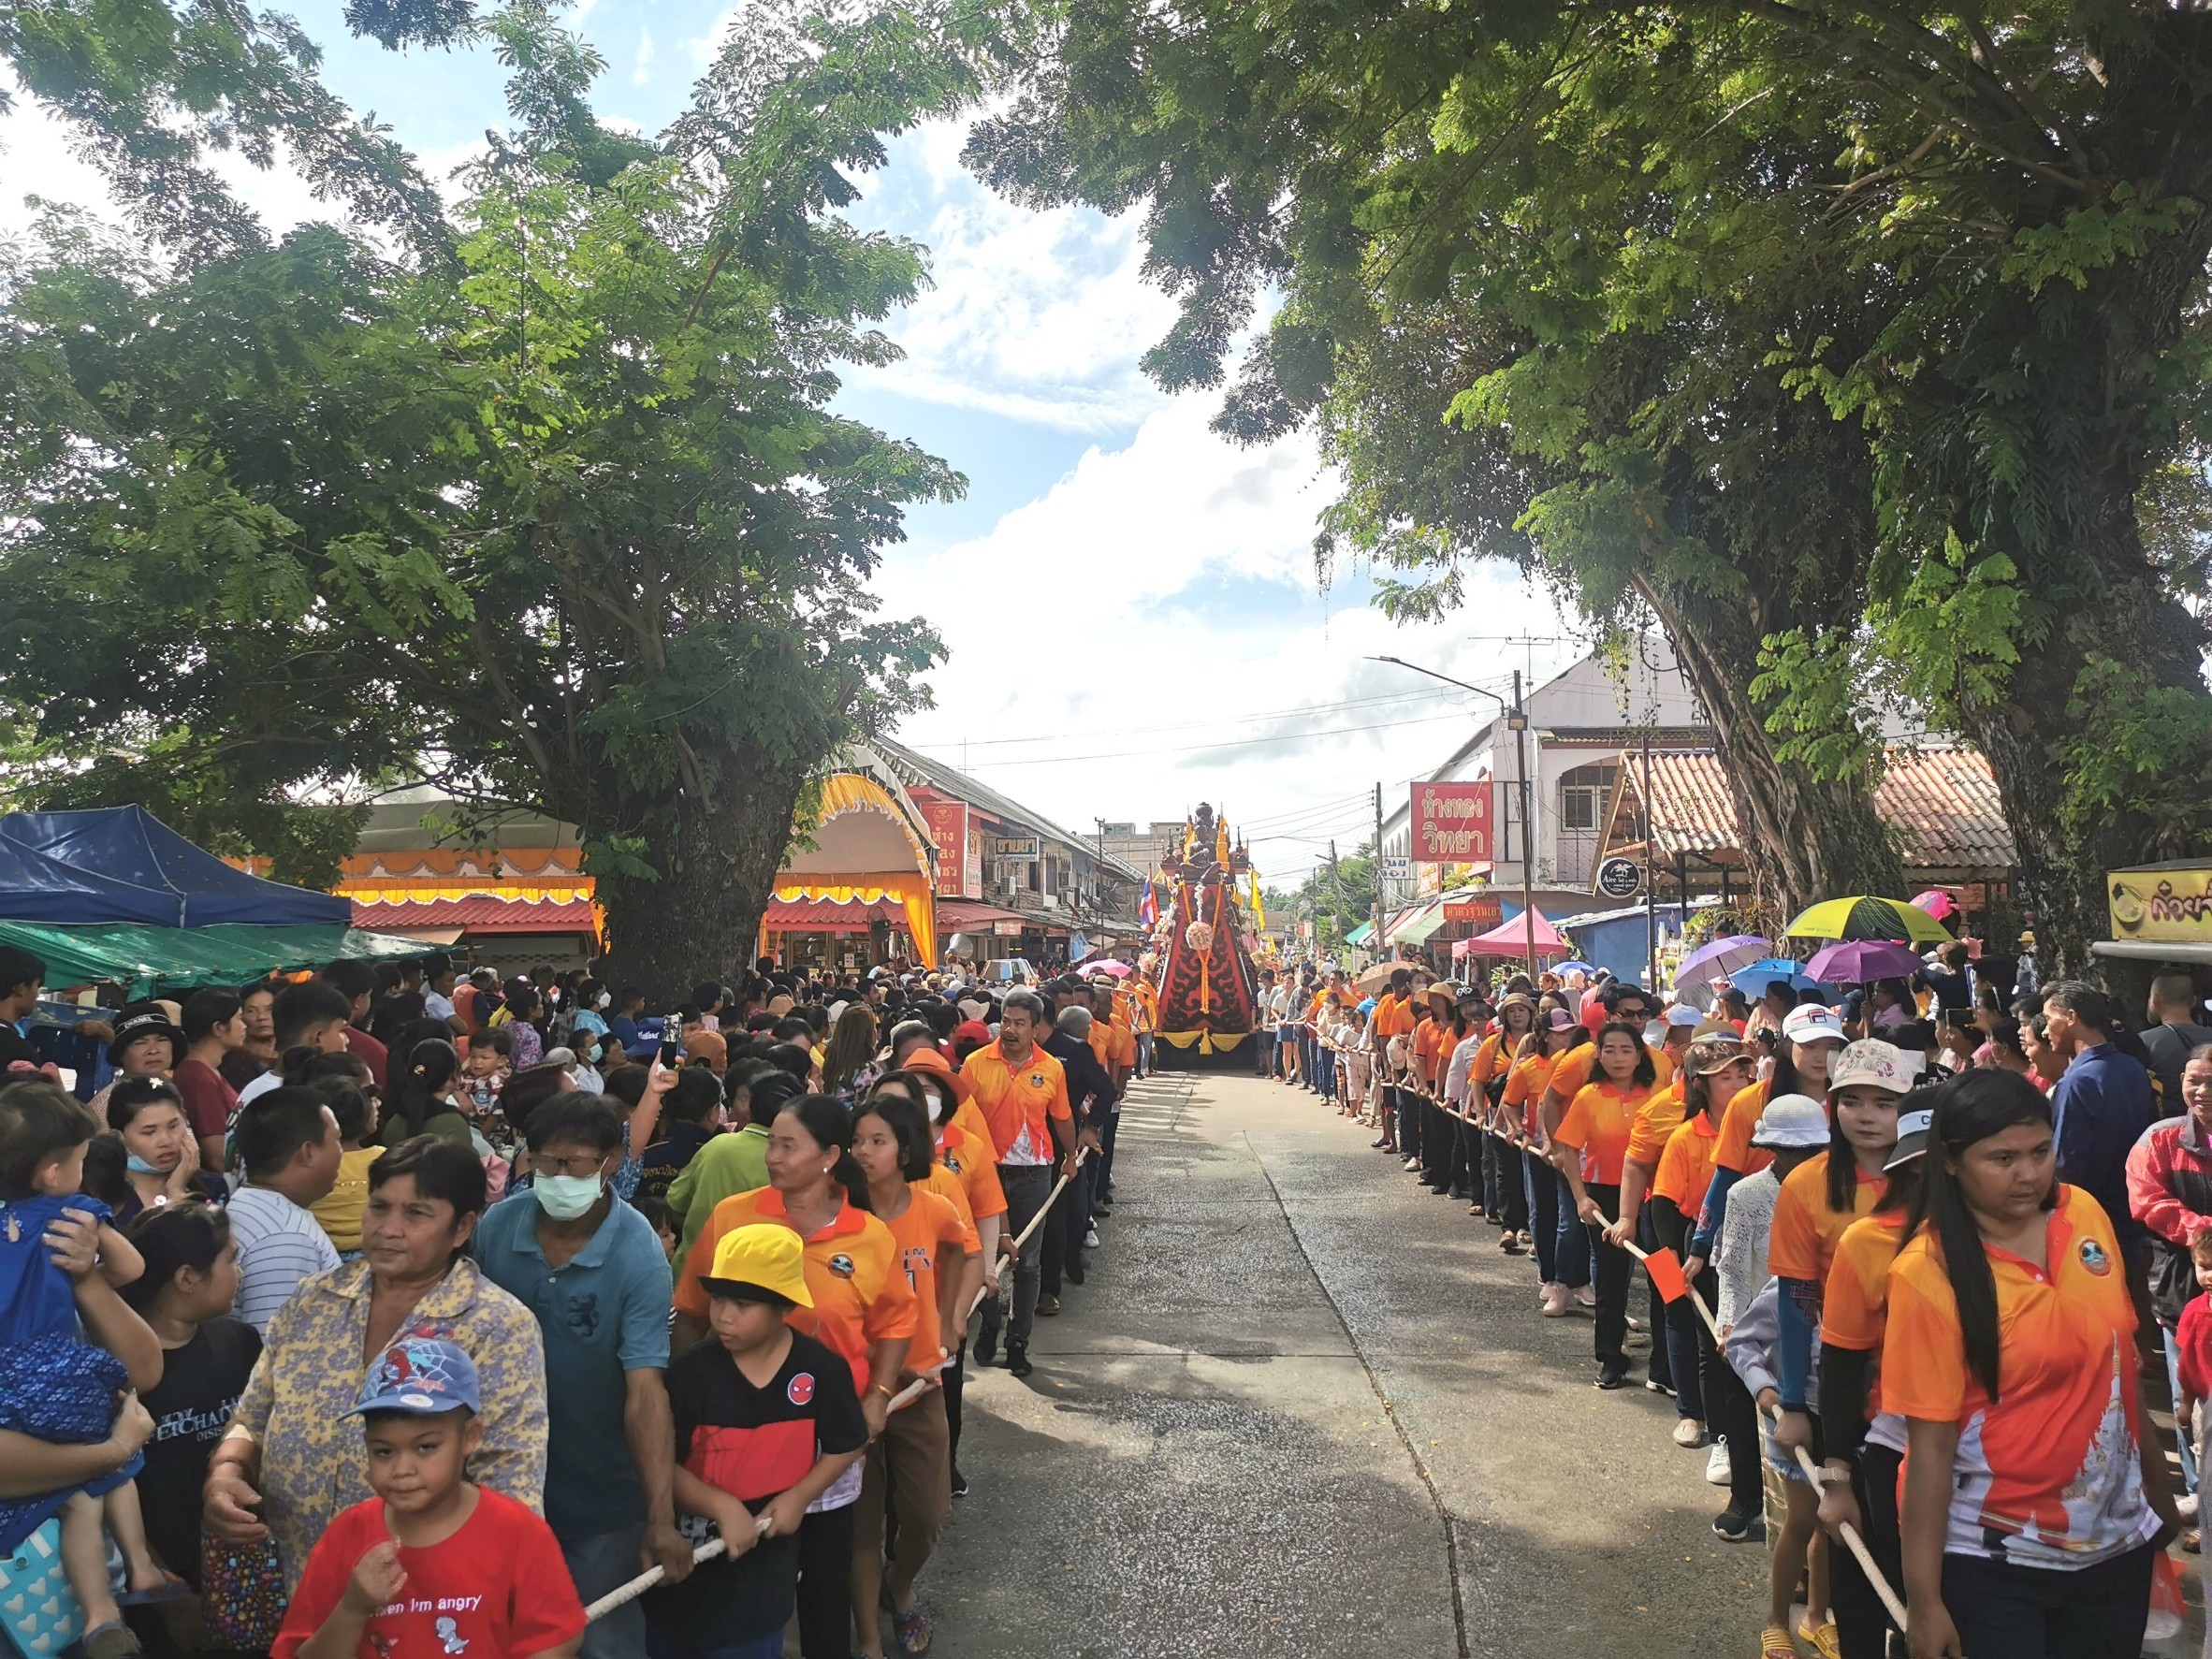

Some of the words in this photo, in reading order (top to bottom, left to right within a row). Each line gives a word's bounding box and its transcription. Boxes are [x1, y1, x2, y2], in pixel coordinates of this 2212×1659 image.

[1421, 788, 1484, 818] ห้างทอง
[997, 838, 1036, 852] ขายยา
[1422, 822, 1484, 853] วิทยา
[410, 1597, 432, 1613] I'm
[437, 1594, 483, 1612] angry
